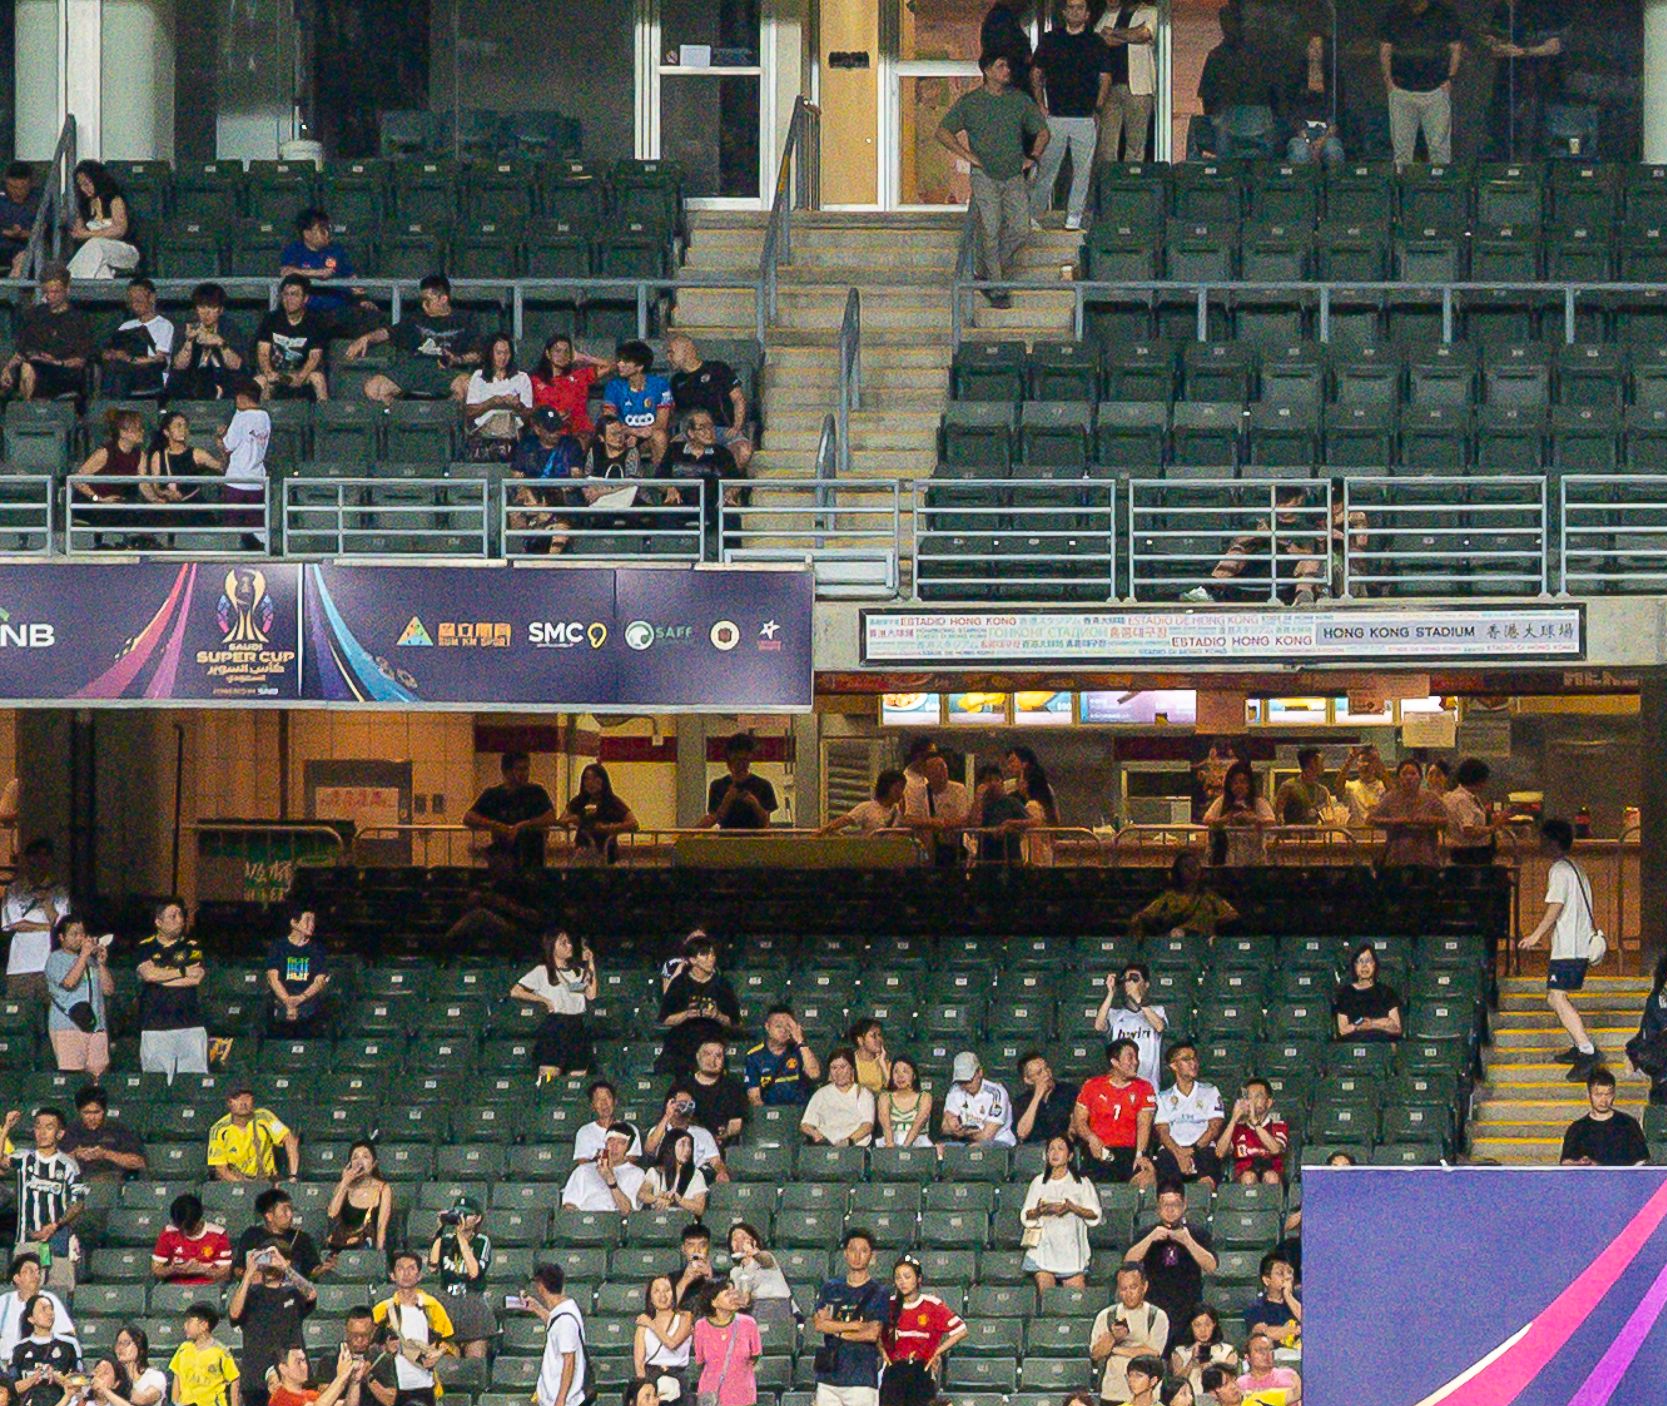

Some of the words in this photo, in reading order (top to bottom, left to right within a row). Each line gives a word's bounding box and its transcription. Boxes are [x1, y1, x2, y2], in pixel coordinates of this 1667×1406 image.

[900, 617, 946, 626] ESTADIO
[950, 617, 982, 626] HONG
[985, 617, 1017, 626] KONG
[0, 624, 55, 647] NB
[529, 622, 584, 642] SMC
[655, 627, 693, 639] SAFF
[1323, 626, 1365, 638] HONG
[1369, 626, 1410, 638] KONG
[1415, 626, 1475, 638] STADIUM
[1171, 636, 1226, 647] ESTADIO
[1232, 636, 1269, 647] HONG
[1275, 636, 1312, 647] KONG
[196, 651, 256, 663] SUPER
[260, 651, 295, 663] CUP
